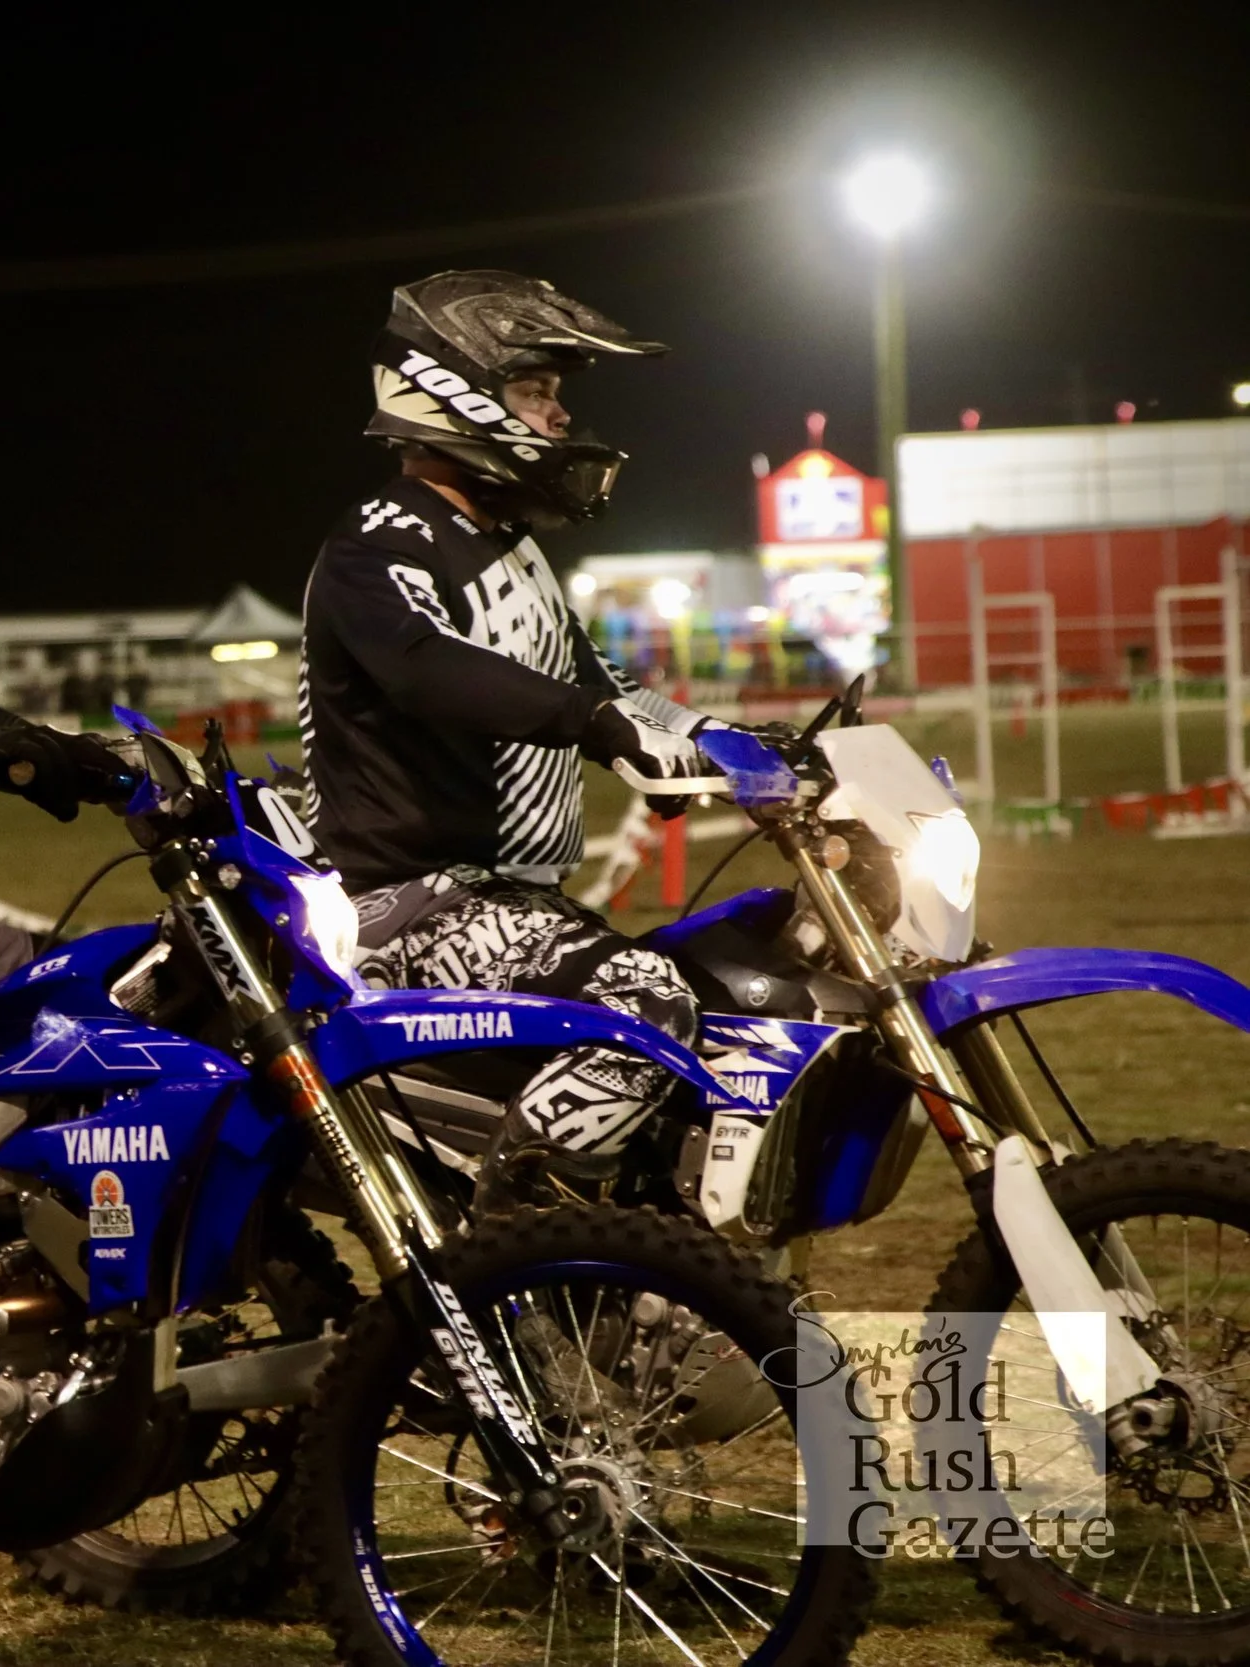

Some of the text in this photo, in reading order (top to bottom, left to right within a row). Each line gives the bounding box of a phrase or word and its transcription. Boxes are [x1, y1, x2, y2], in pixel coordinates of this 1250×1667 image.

[399, 349, 554, 462] 100%
[401, 1010, 514, 1042] YAMAHA
[62, 1124, 171, 1165] YAMAHA
[715, 1126, 750, 1139] GYTR
[430, 1327, 497, 1420] GYTR
[433, 1280, 538, 1446] DUNLOP
